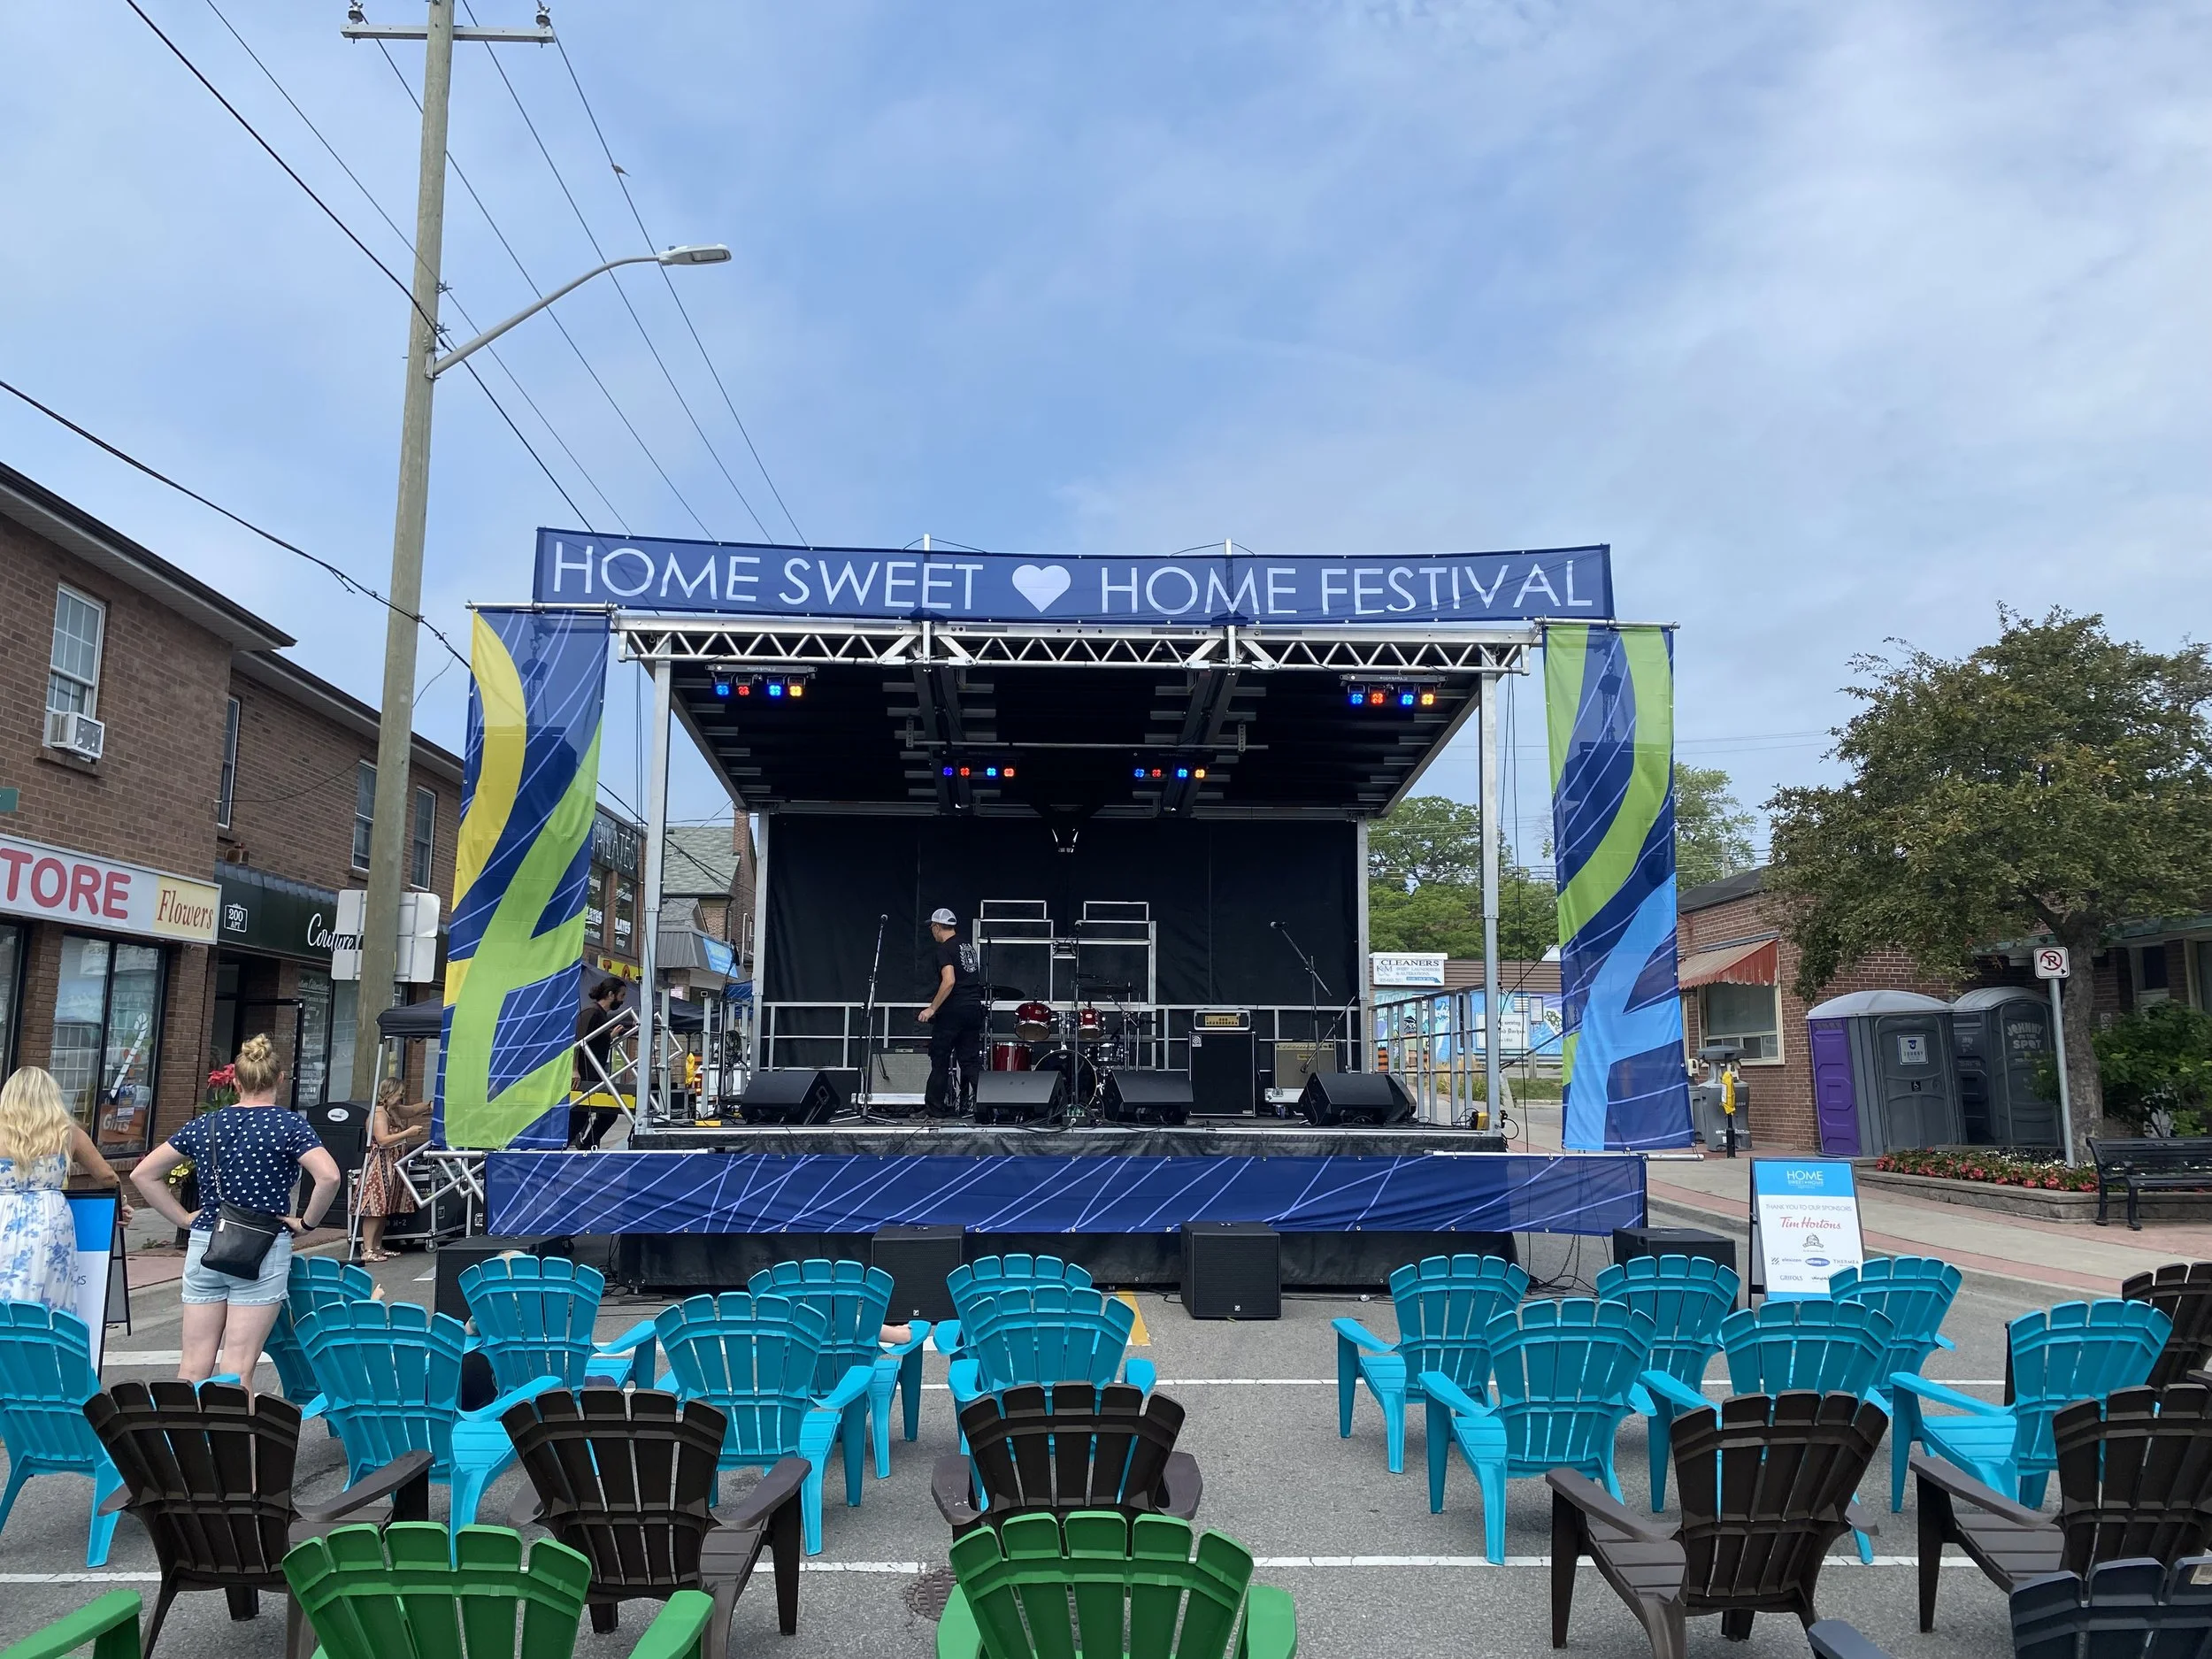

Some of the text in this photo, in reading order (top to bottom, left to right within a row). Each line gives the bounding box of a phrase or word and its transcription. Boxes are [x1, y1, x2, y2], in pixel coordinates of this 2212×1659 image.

[553, 541, 1593, 615] HOME SWEET HOME FESTIVAL
[597, 821, 636, 871] PILATES
[0, 848, 132, 920] TORE
[157, 888, 214, 930] Flowers
[227, 908, 244, 923] 200
[2007, 1022, 2043, 1036] JOHNNY
[2013, 1040, 2042, 1049] SPOT
[1787, 1170, 1824, 1180] HOME
[1779, 1216, 1841, 1230] Tim Hortons
